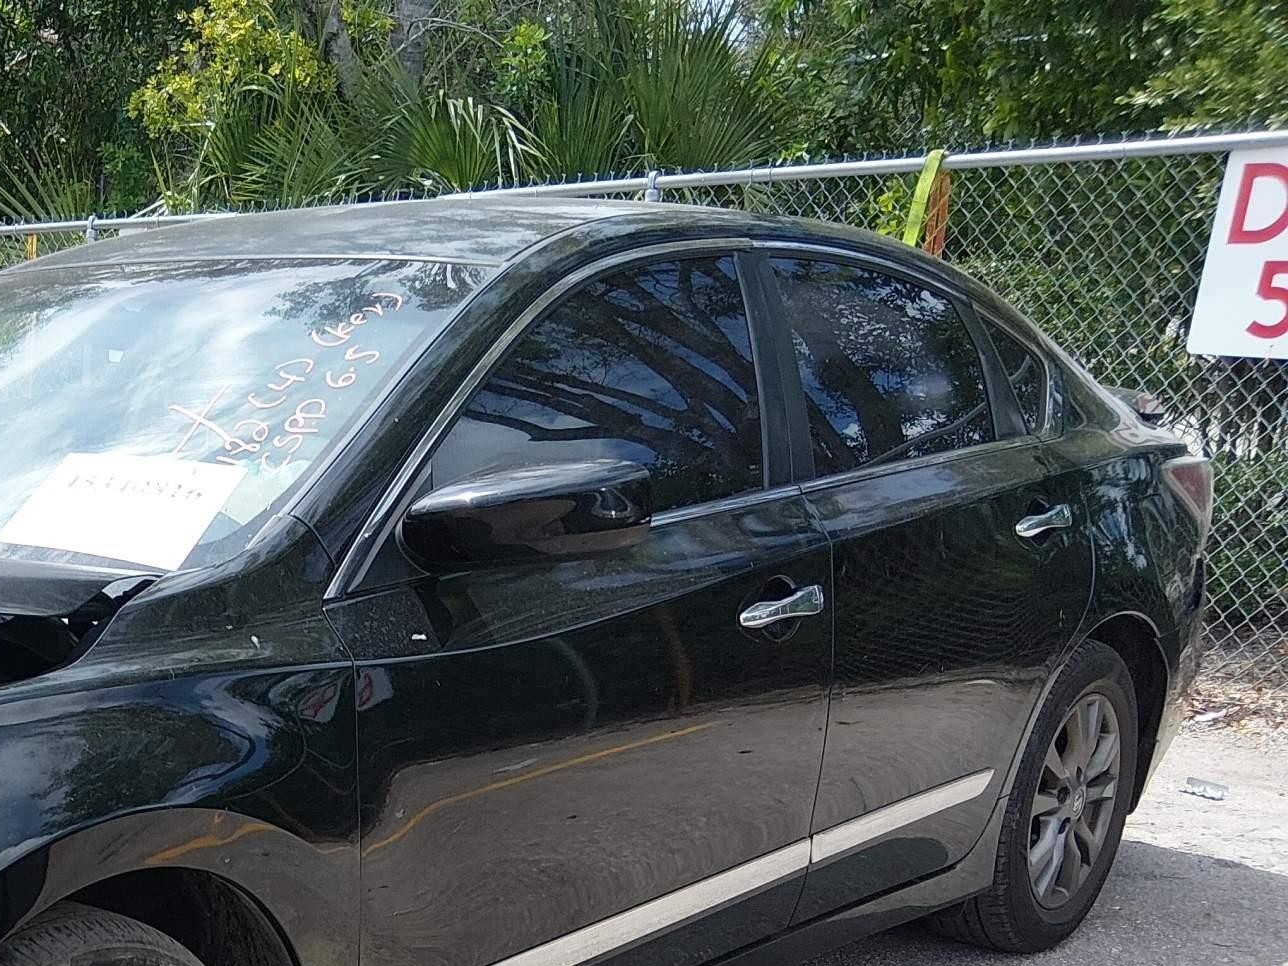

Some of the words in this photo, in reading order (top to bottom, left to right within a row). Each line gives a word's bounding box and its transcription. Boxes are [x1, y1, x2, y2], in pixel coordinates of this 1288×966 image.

[1227, 163, 1288, 244] D
[1245, 260, 1288, 339] 5
[215, 418, 270, 467] 182
